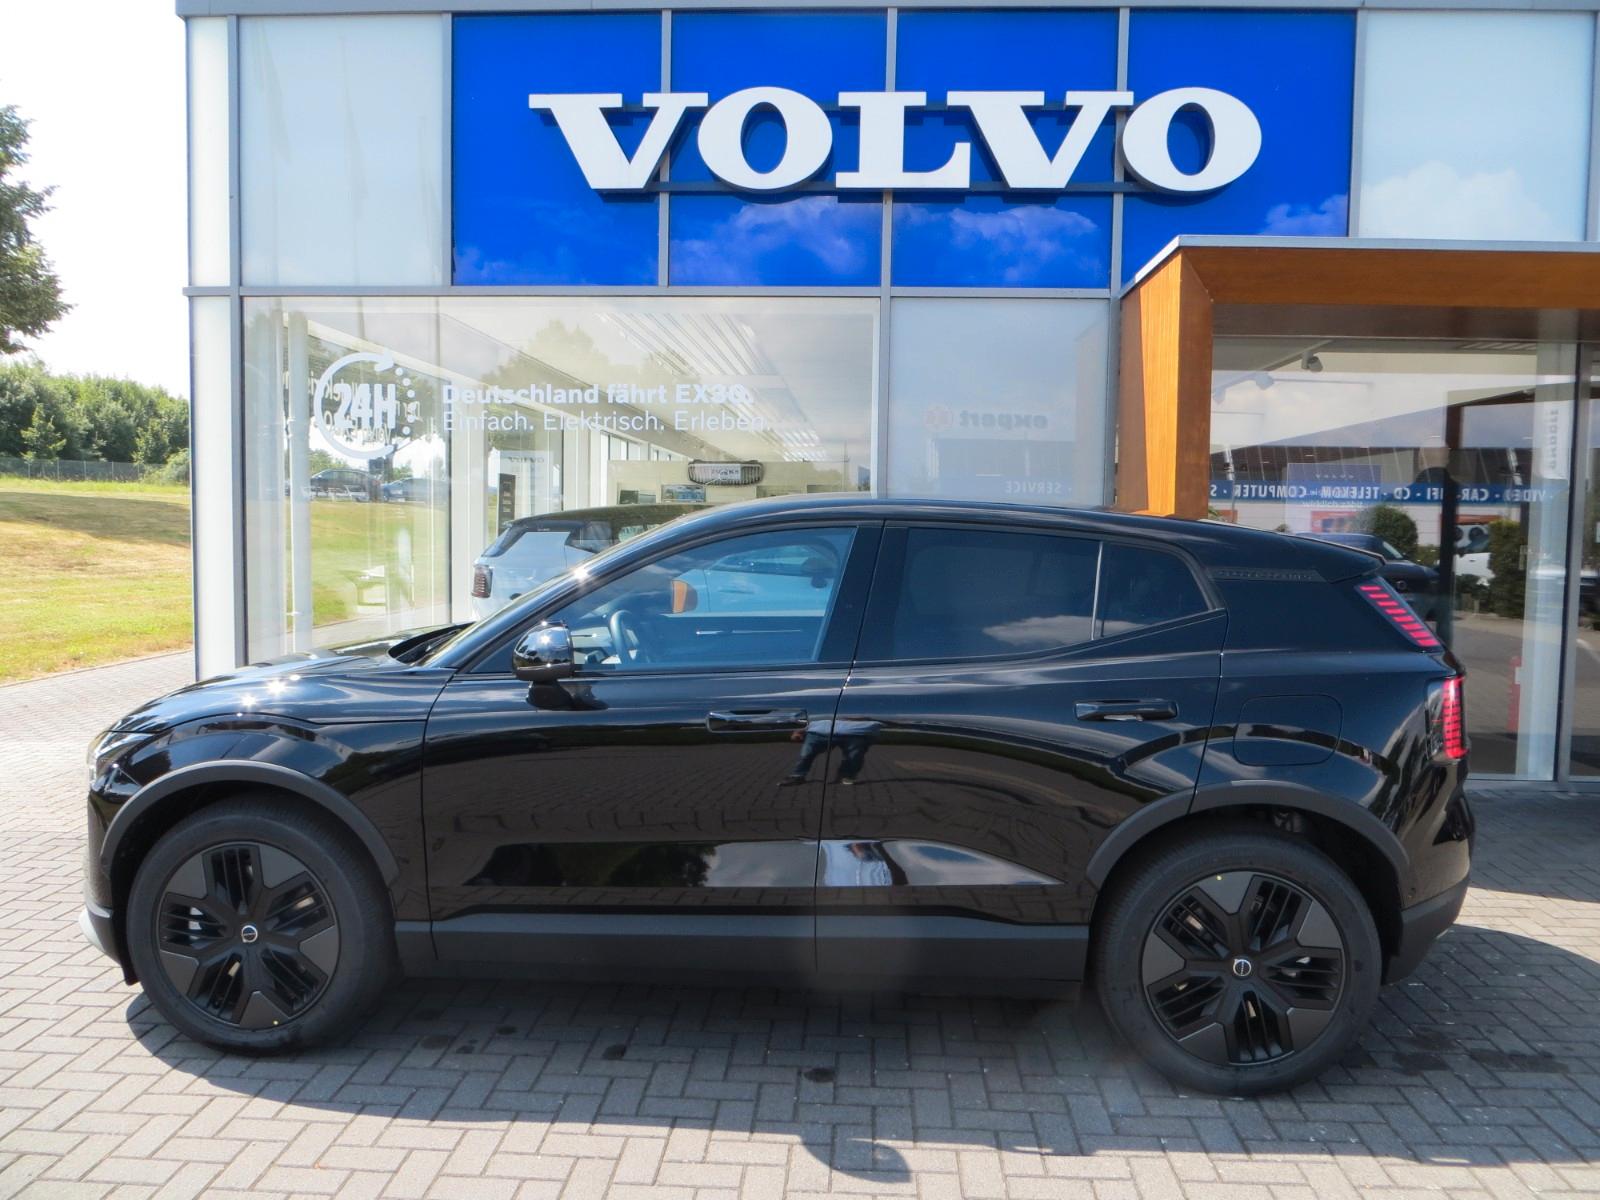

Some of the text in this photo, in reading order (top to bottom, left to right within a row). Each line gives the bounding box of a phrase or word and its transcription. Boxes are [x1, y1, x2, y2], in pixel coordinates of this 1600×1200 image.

[528, 86, 1262, 190] VOLVO
[333, 383, 396, 429] 24H
[442, 383, 600, 404] Deutschland
[606, 383, 668, 404] fährt
[443, 410, 535, 432] Einfach.
[543, 410, 665, 432] Elektrisch.
[674, 410, 771, 432] Erleben.
